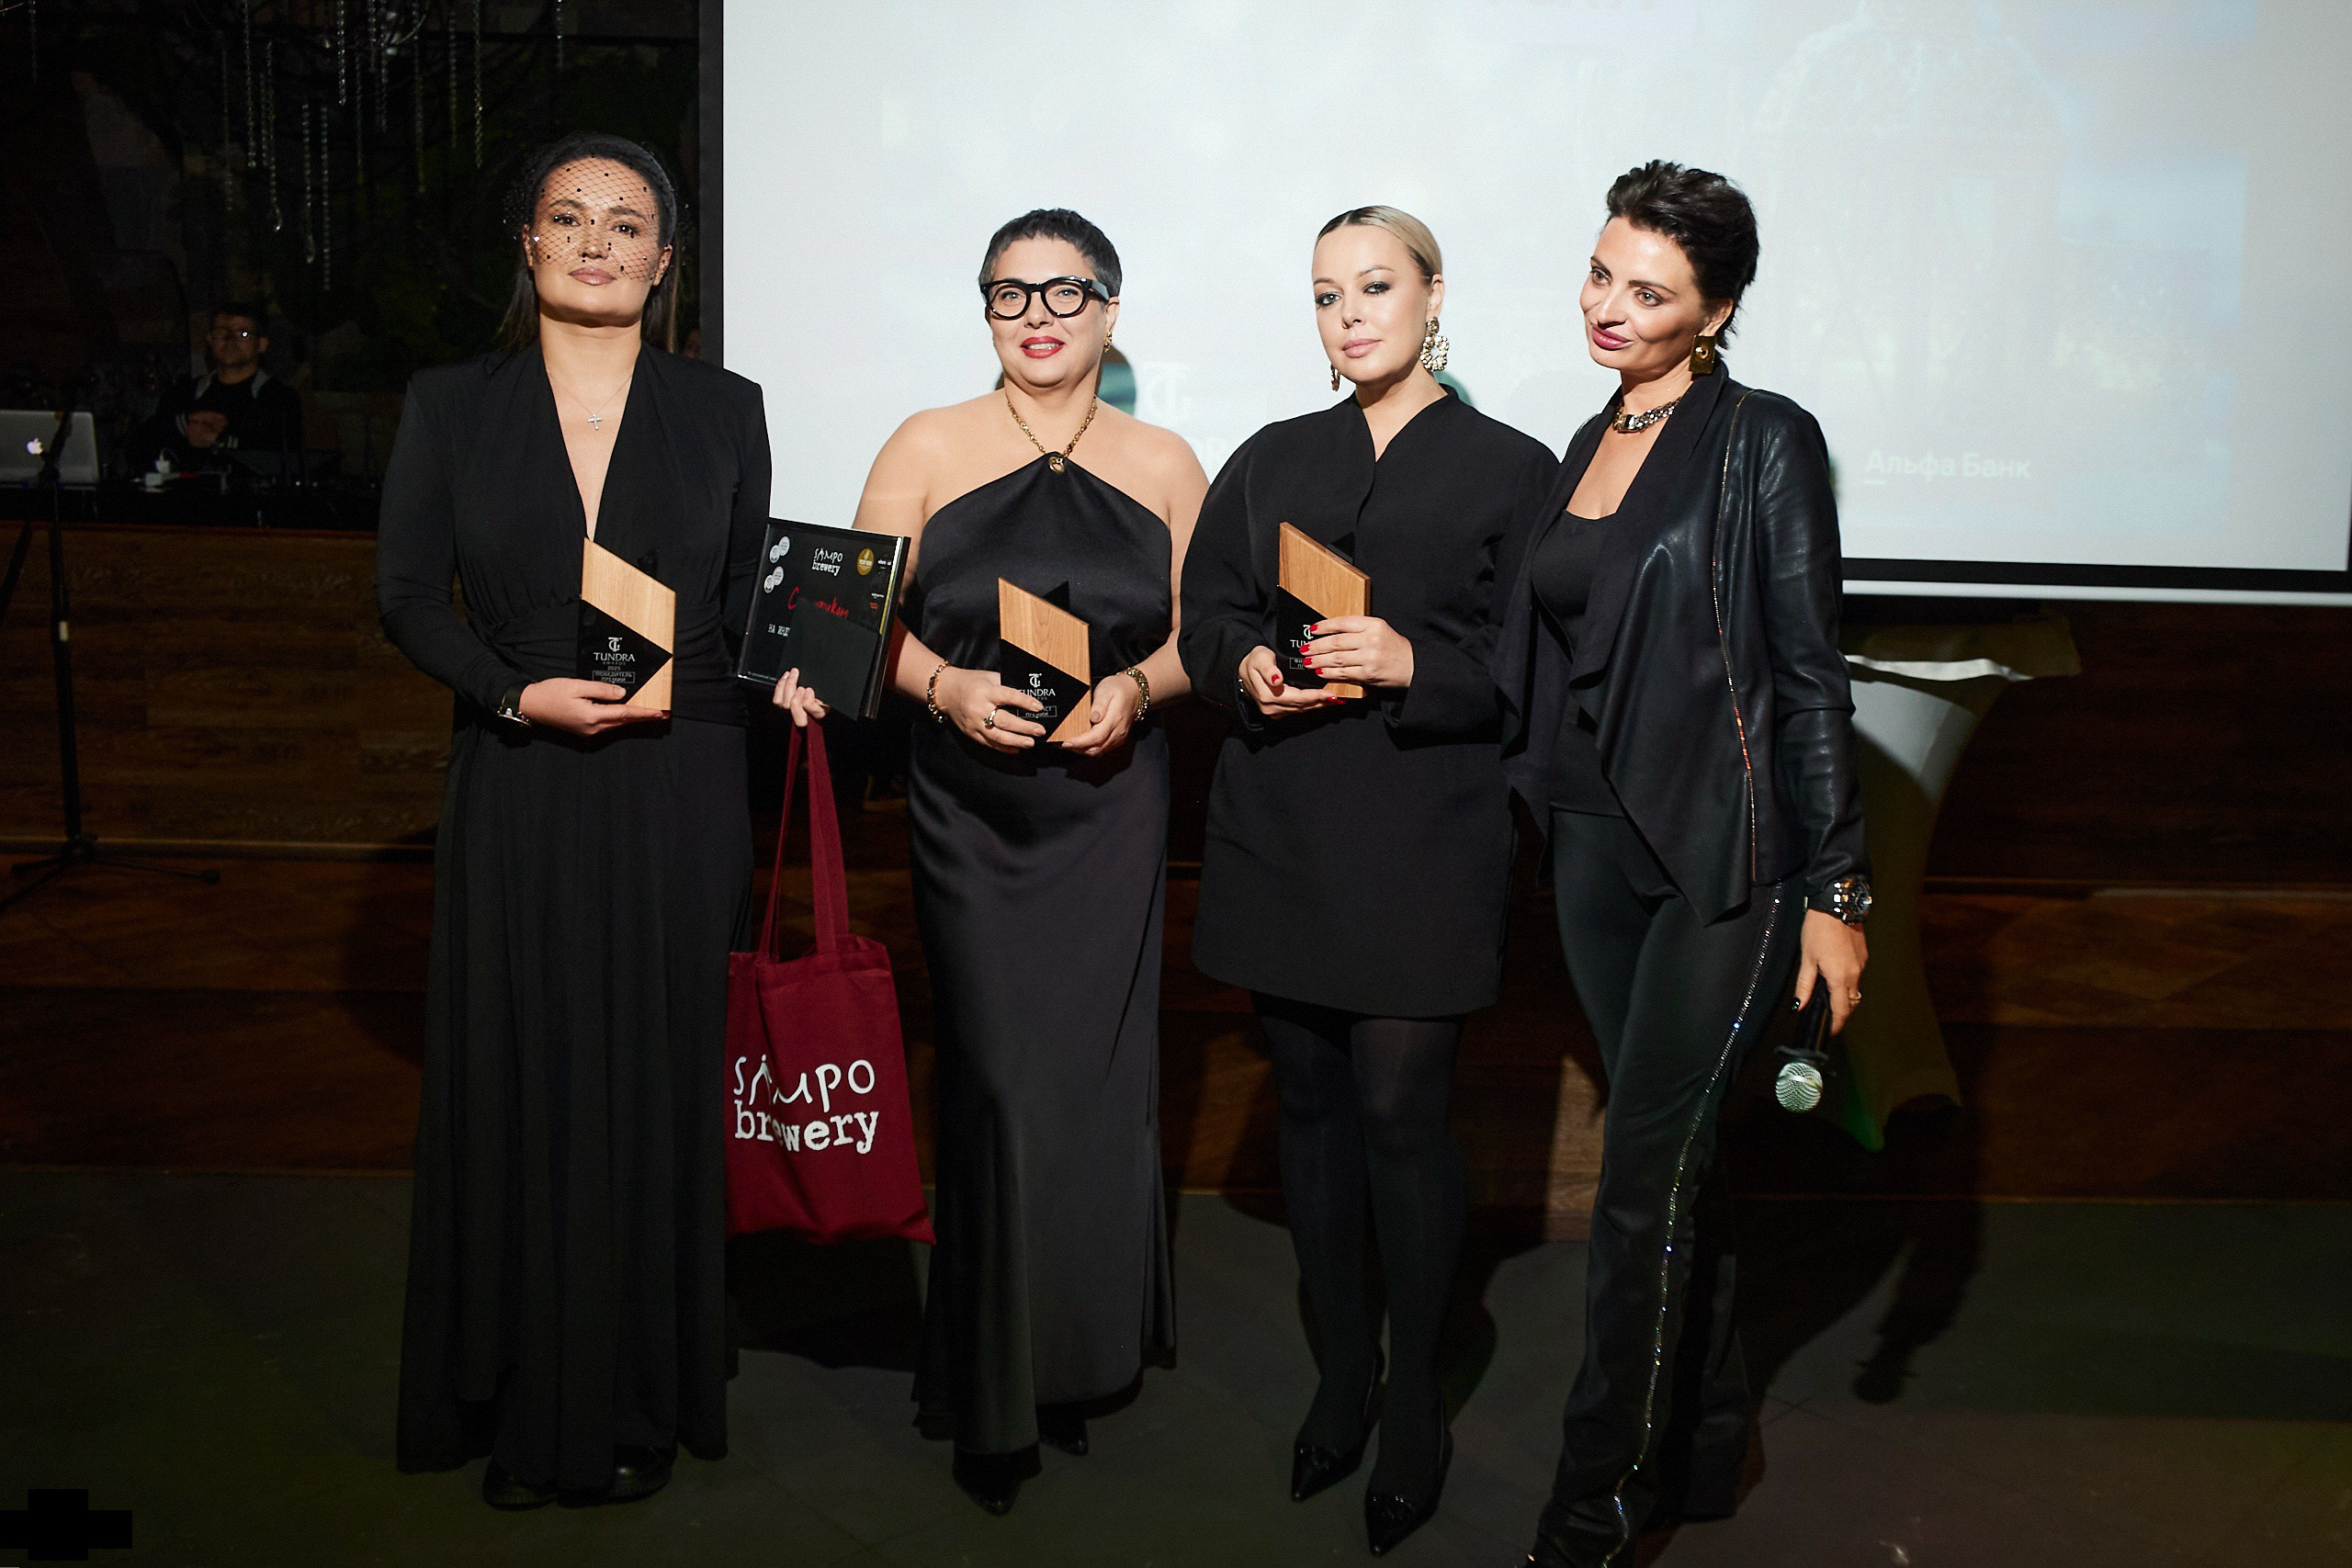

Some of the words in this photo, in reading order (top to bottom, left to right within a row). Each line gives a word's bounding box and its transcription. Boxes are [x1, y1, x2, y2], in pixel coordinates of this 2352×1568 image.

[1863, 447, 1957, 484] Альфа
[1962, 451, 2032, 479] Банк
[811, 559, 841, 577] brewery
[593, 652, 636, 662] TUNDRA
[1020, 688, 1057, 697] UNDRA
[733, 1099, 879, 1155] brewery
